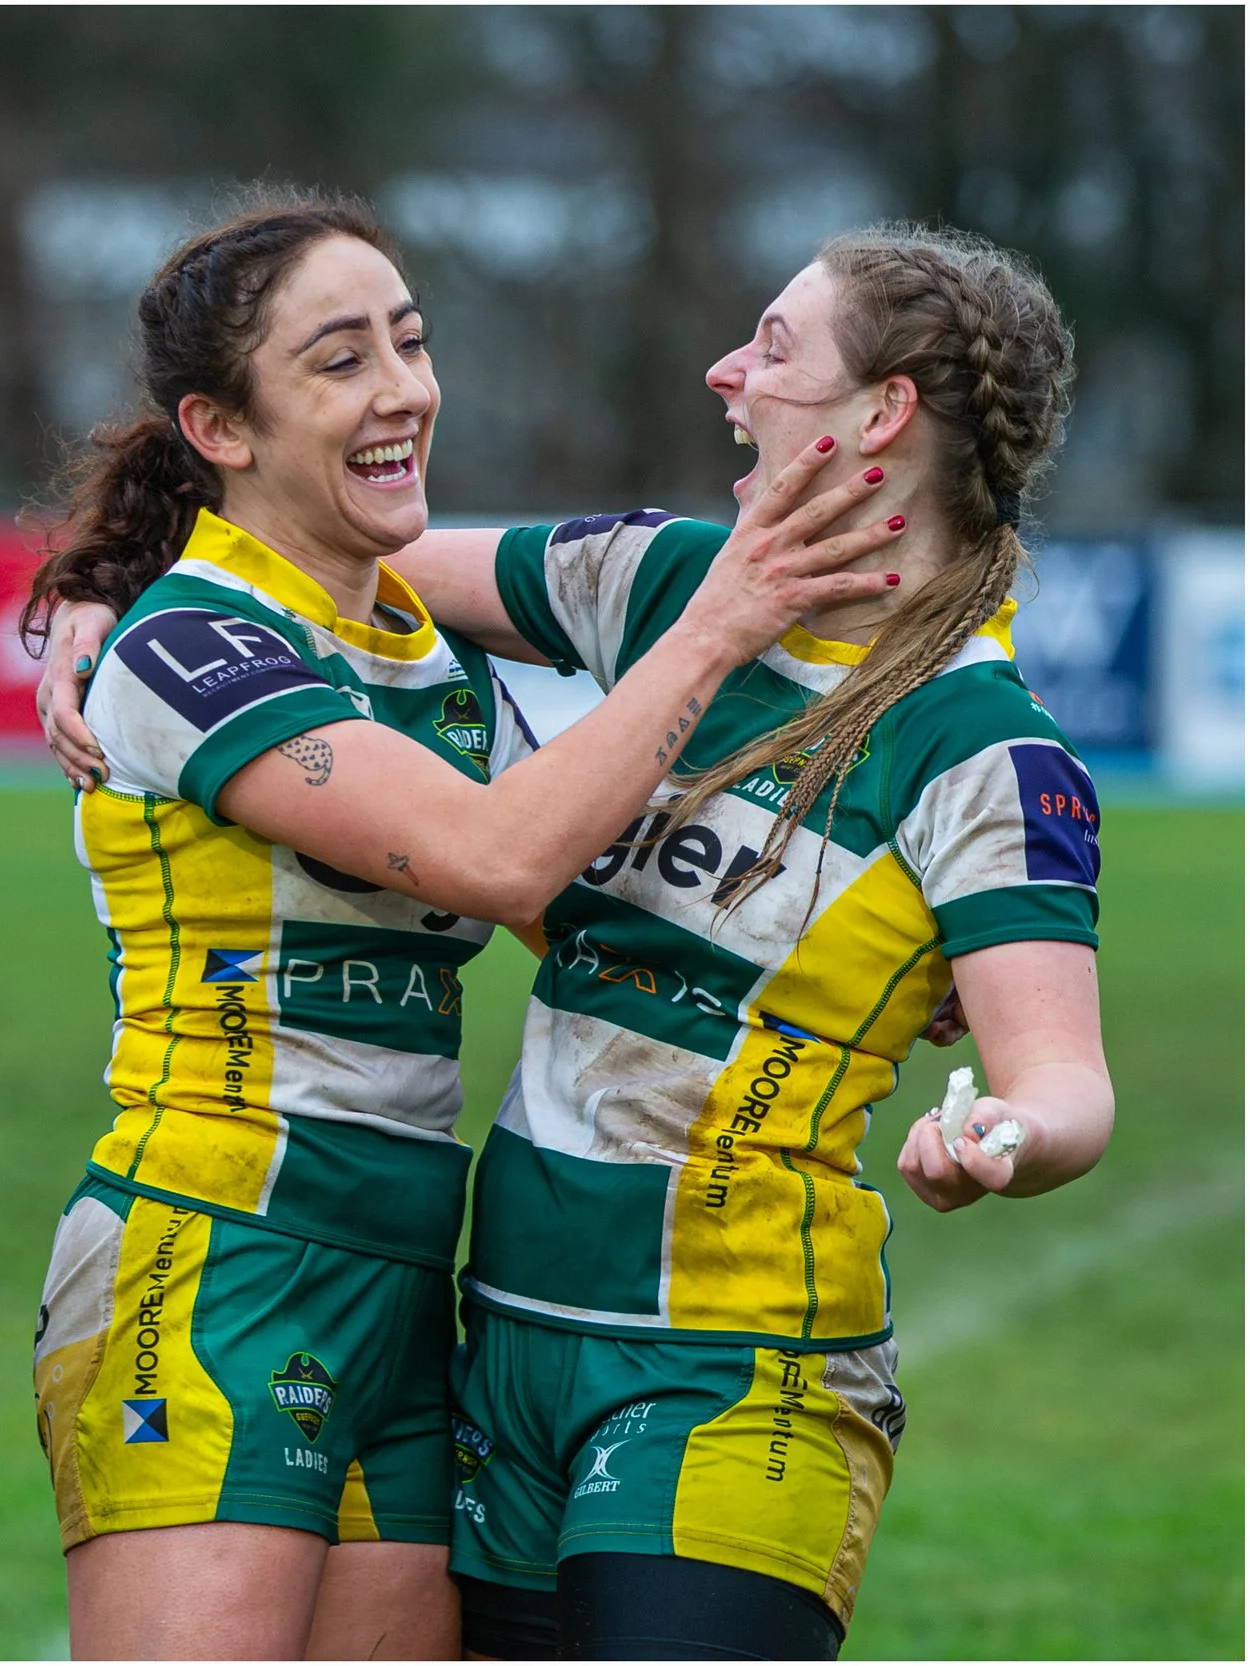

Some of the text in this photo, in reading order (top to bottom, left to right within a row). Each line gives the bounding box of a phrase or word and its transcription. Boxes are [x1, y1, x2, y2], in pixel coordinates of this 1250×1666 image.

[146, 616, 262, 683] LF
[191, 655, 292, 694] LEAPFROG
[284, 1447, 329, 1475] LADIES
[574, 1480, 621, 1499] GILBERT
